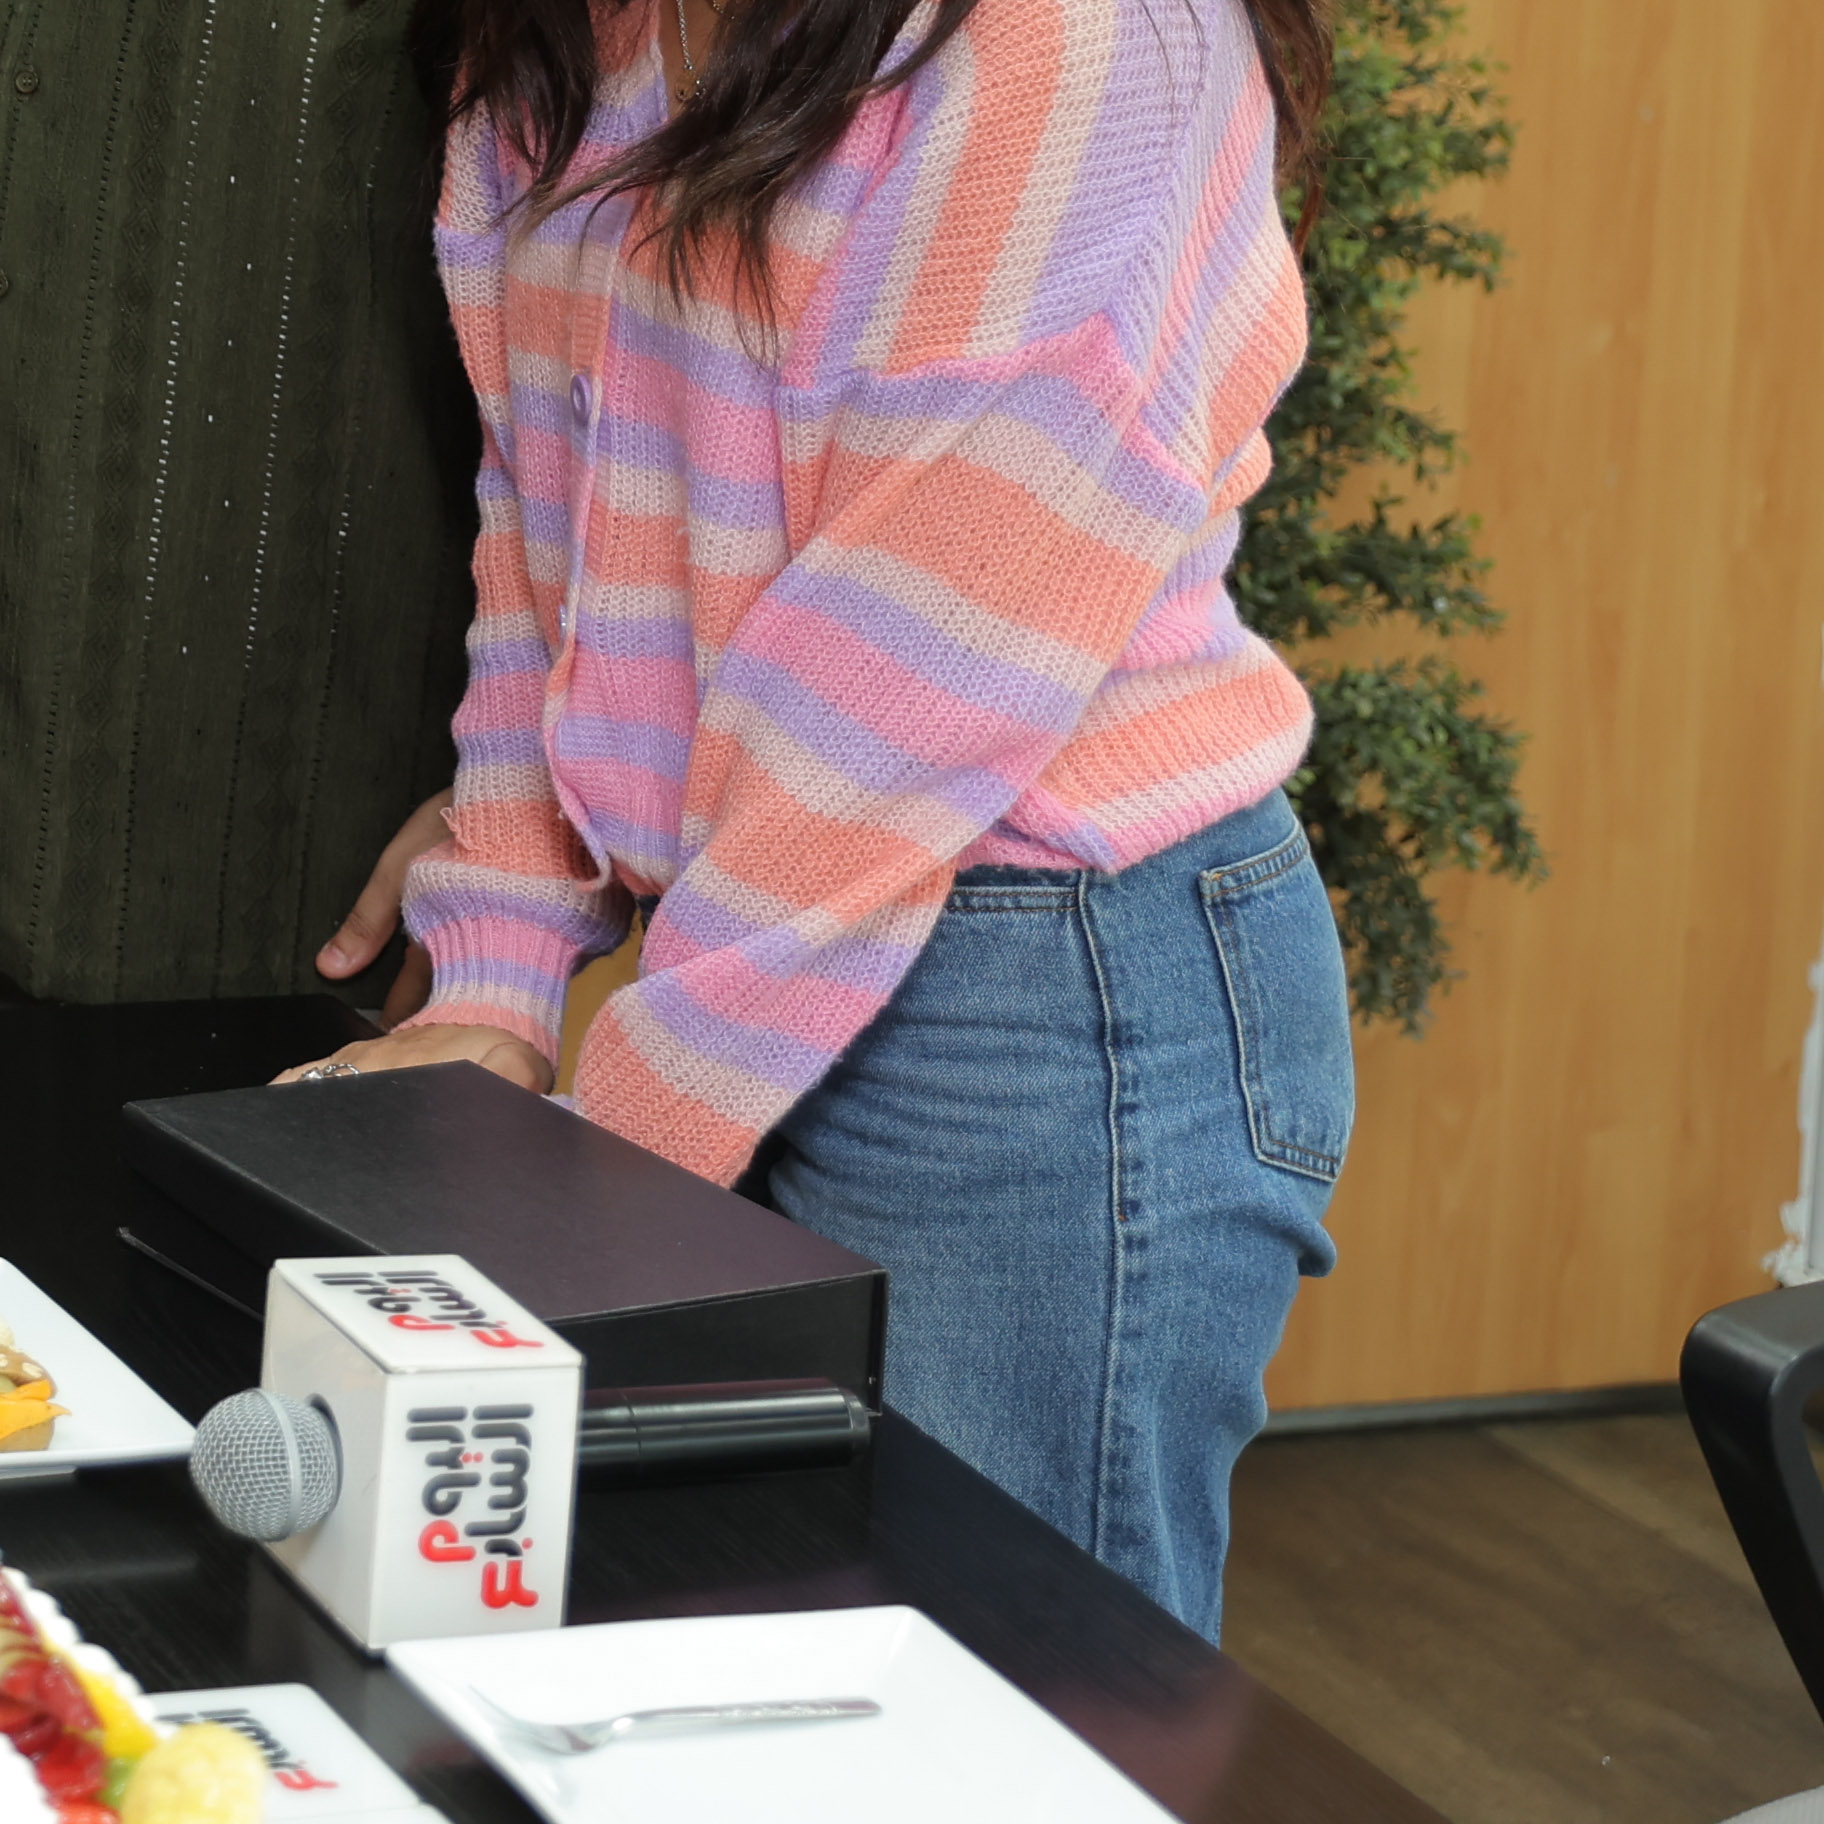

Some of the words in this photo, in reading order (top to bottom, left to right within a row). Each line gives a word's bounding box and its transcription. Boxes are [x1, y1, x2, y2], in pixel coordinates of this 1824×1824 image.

[314, 1271, 455, 1331] اليوم
[377, 1270, 544, 1348] السابع
[406, 1406, 484, 1563] اليوم
[465, 1403, 539, 1609] السابع
